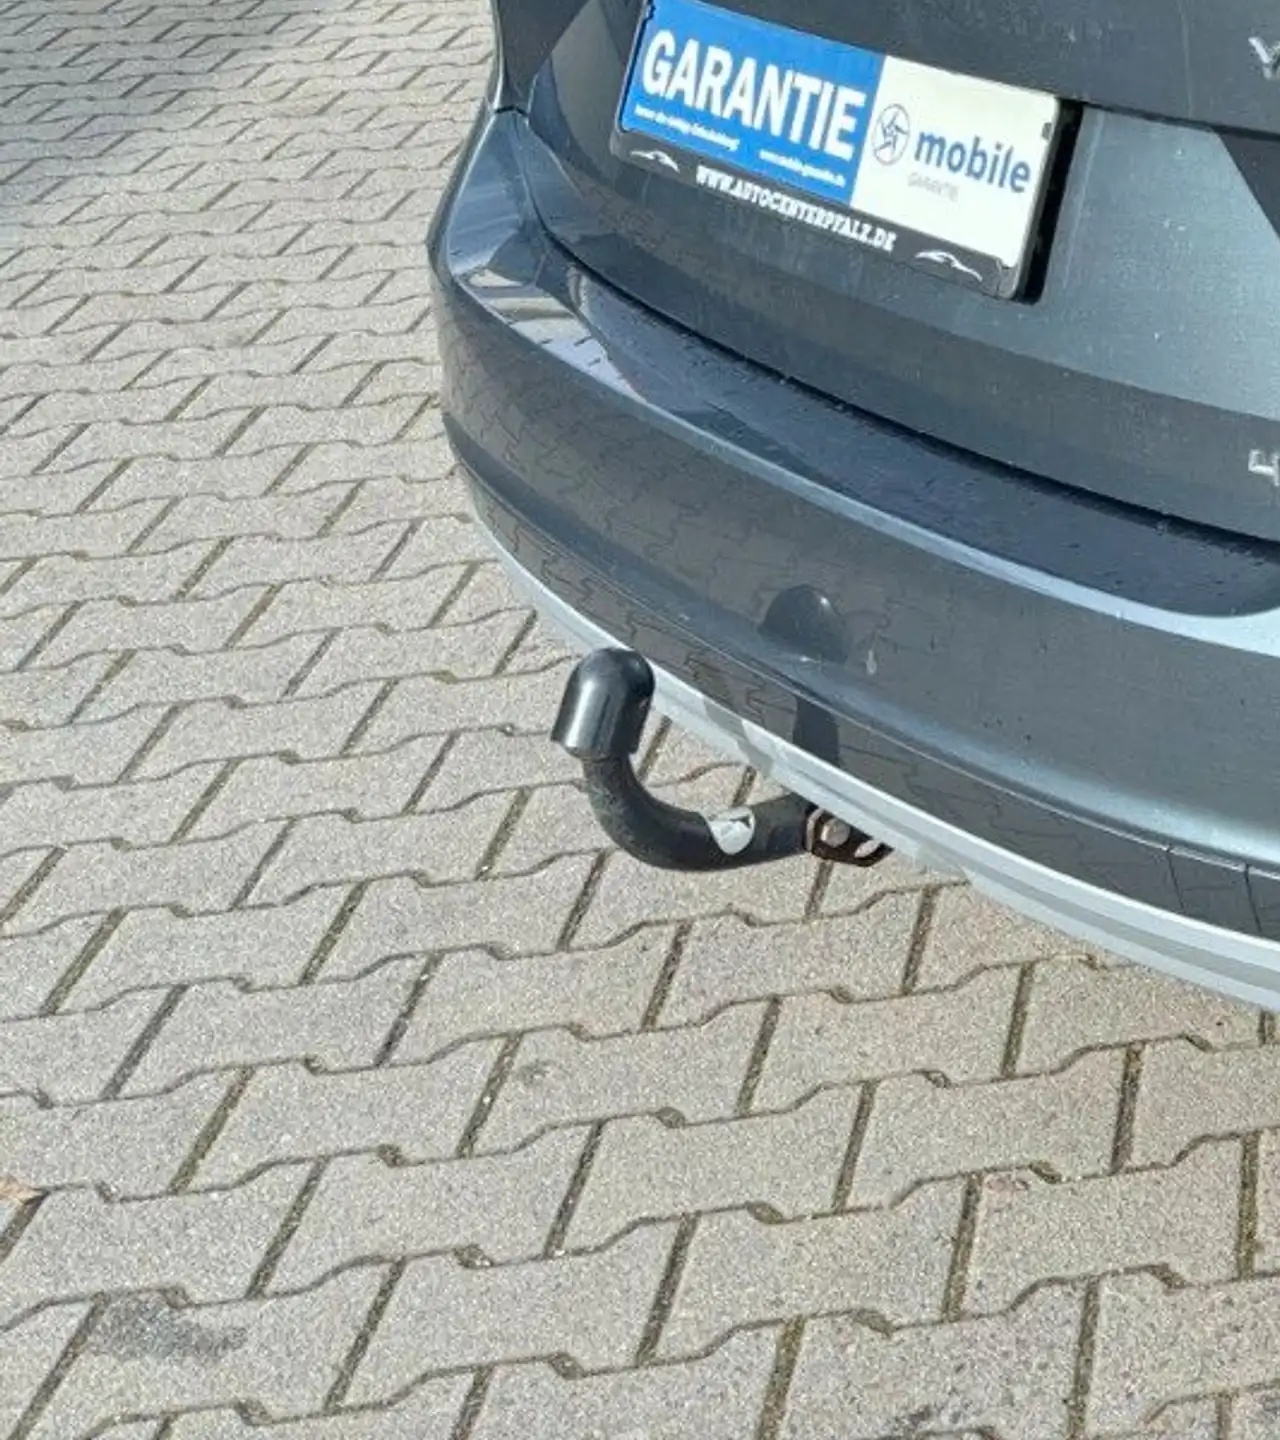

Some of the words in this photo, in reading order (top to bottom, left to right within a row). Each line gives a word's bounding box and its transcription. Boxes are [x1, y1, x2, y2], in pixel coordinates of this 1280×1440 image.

[642, 29, 867, 162] GARANTIE
[914, 130, 1031, 195] mobile
[696, 164, 898, 253] WWW.AUTOCENTERPFALZ.DE
